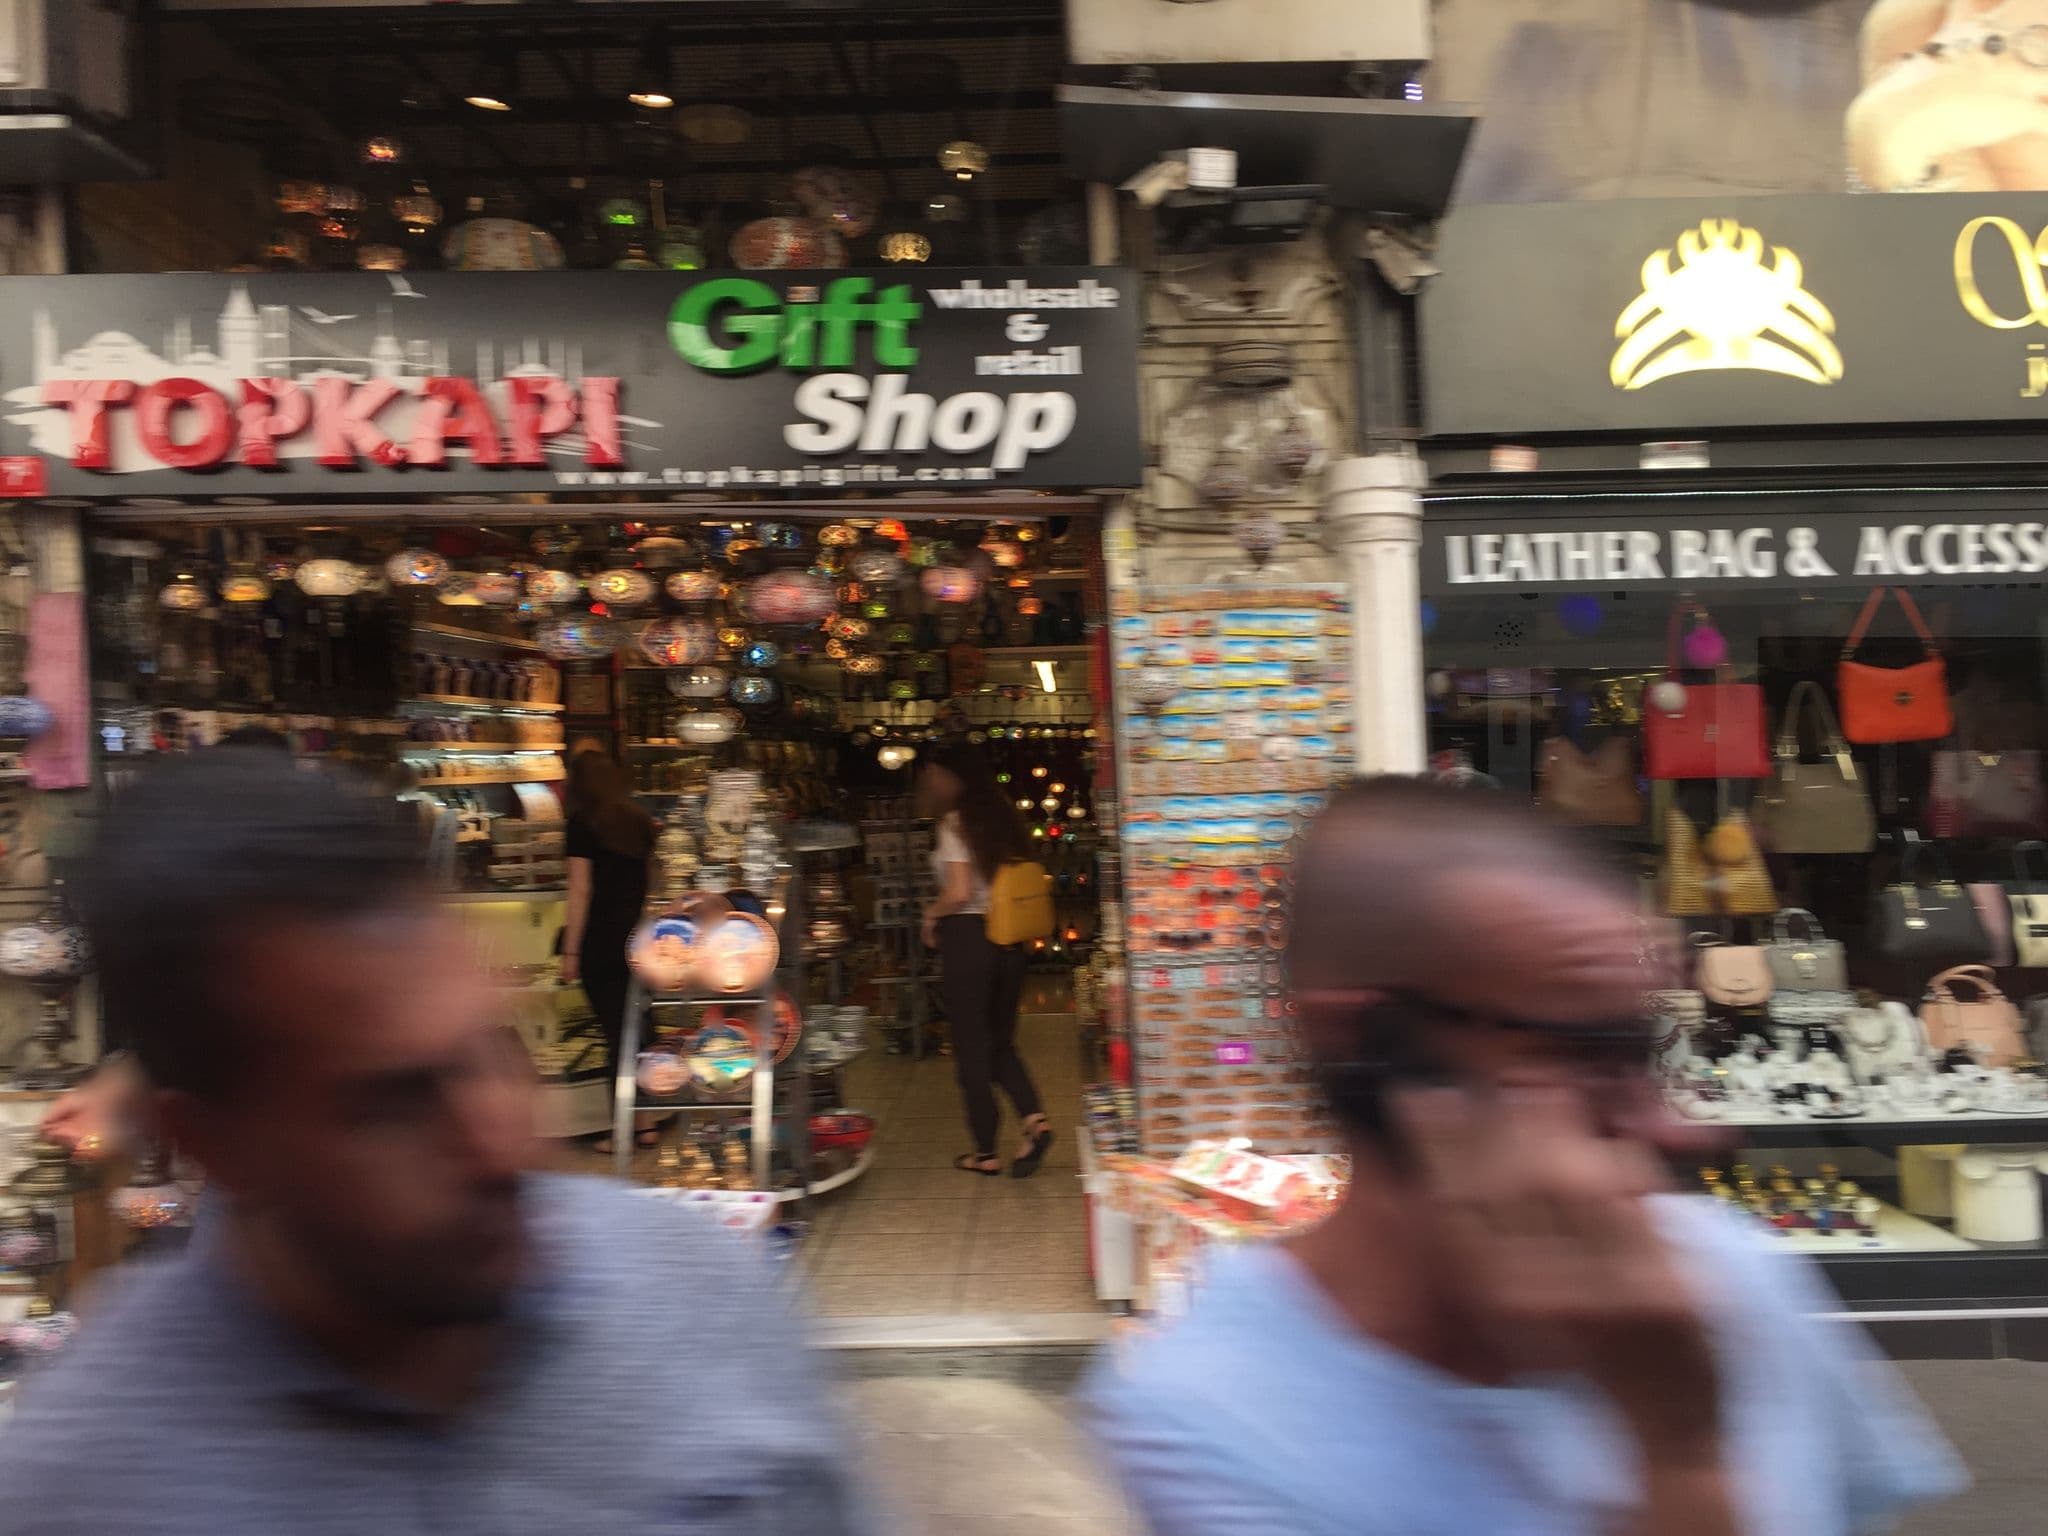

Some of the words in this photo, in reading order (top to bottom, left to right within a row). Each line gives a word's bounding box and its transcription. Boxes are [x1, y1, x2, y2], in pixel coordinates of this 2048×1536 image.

[926, 279, 1121, 309] wholesale
[667, 277, 923, 371] Gift
[1005, 313, 1050, 342] &
[974, 345, 1083, 375] retail
[40, 375, 623, 470] TOPKAPI
[783, 373, 1077, 470] Shop
[553, 464, 998, 488] www.topkapigift.com
[1444, 530, 1666, 584] LEATHER
[1670, 528, 1778, 578] BAG
[1784, 526, 1838, 577] &
[1852, 522, 2048, 576] ACCESS
